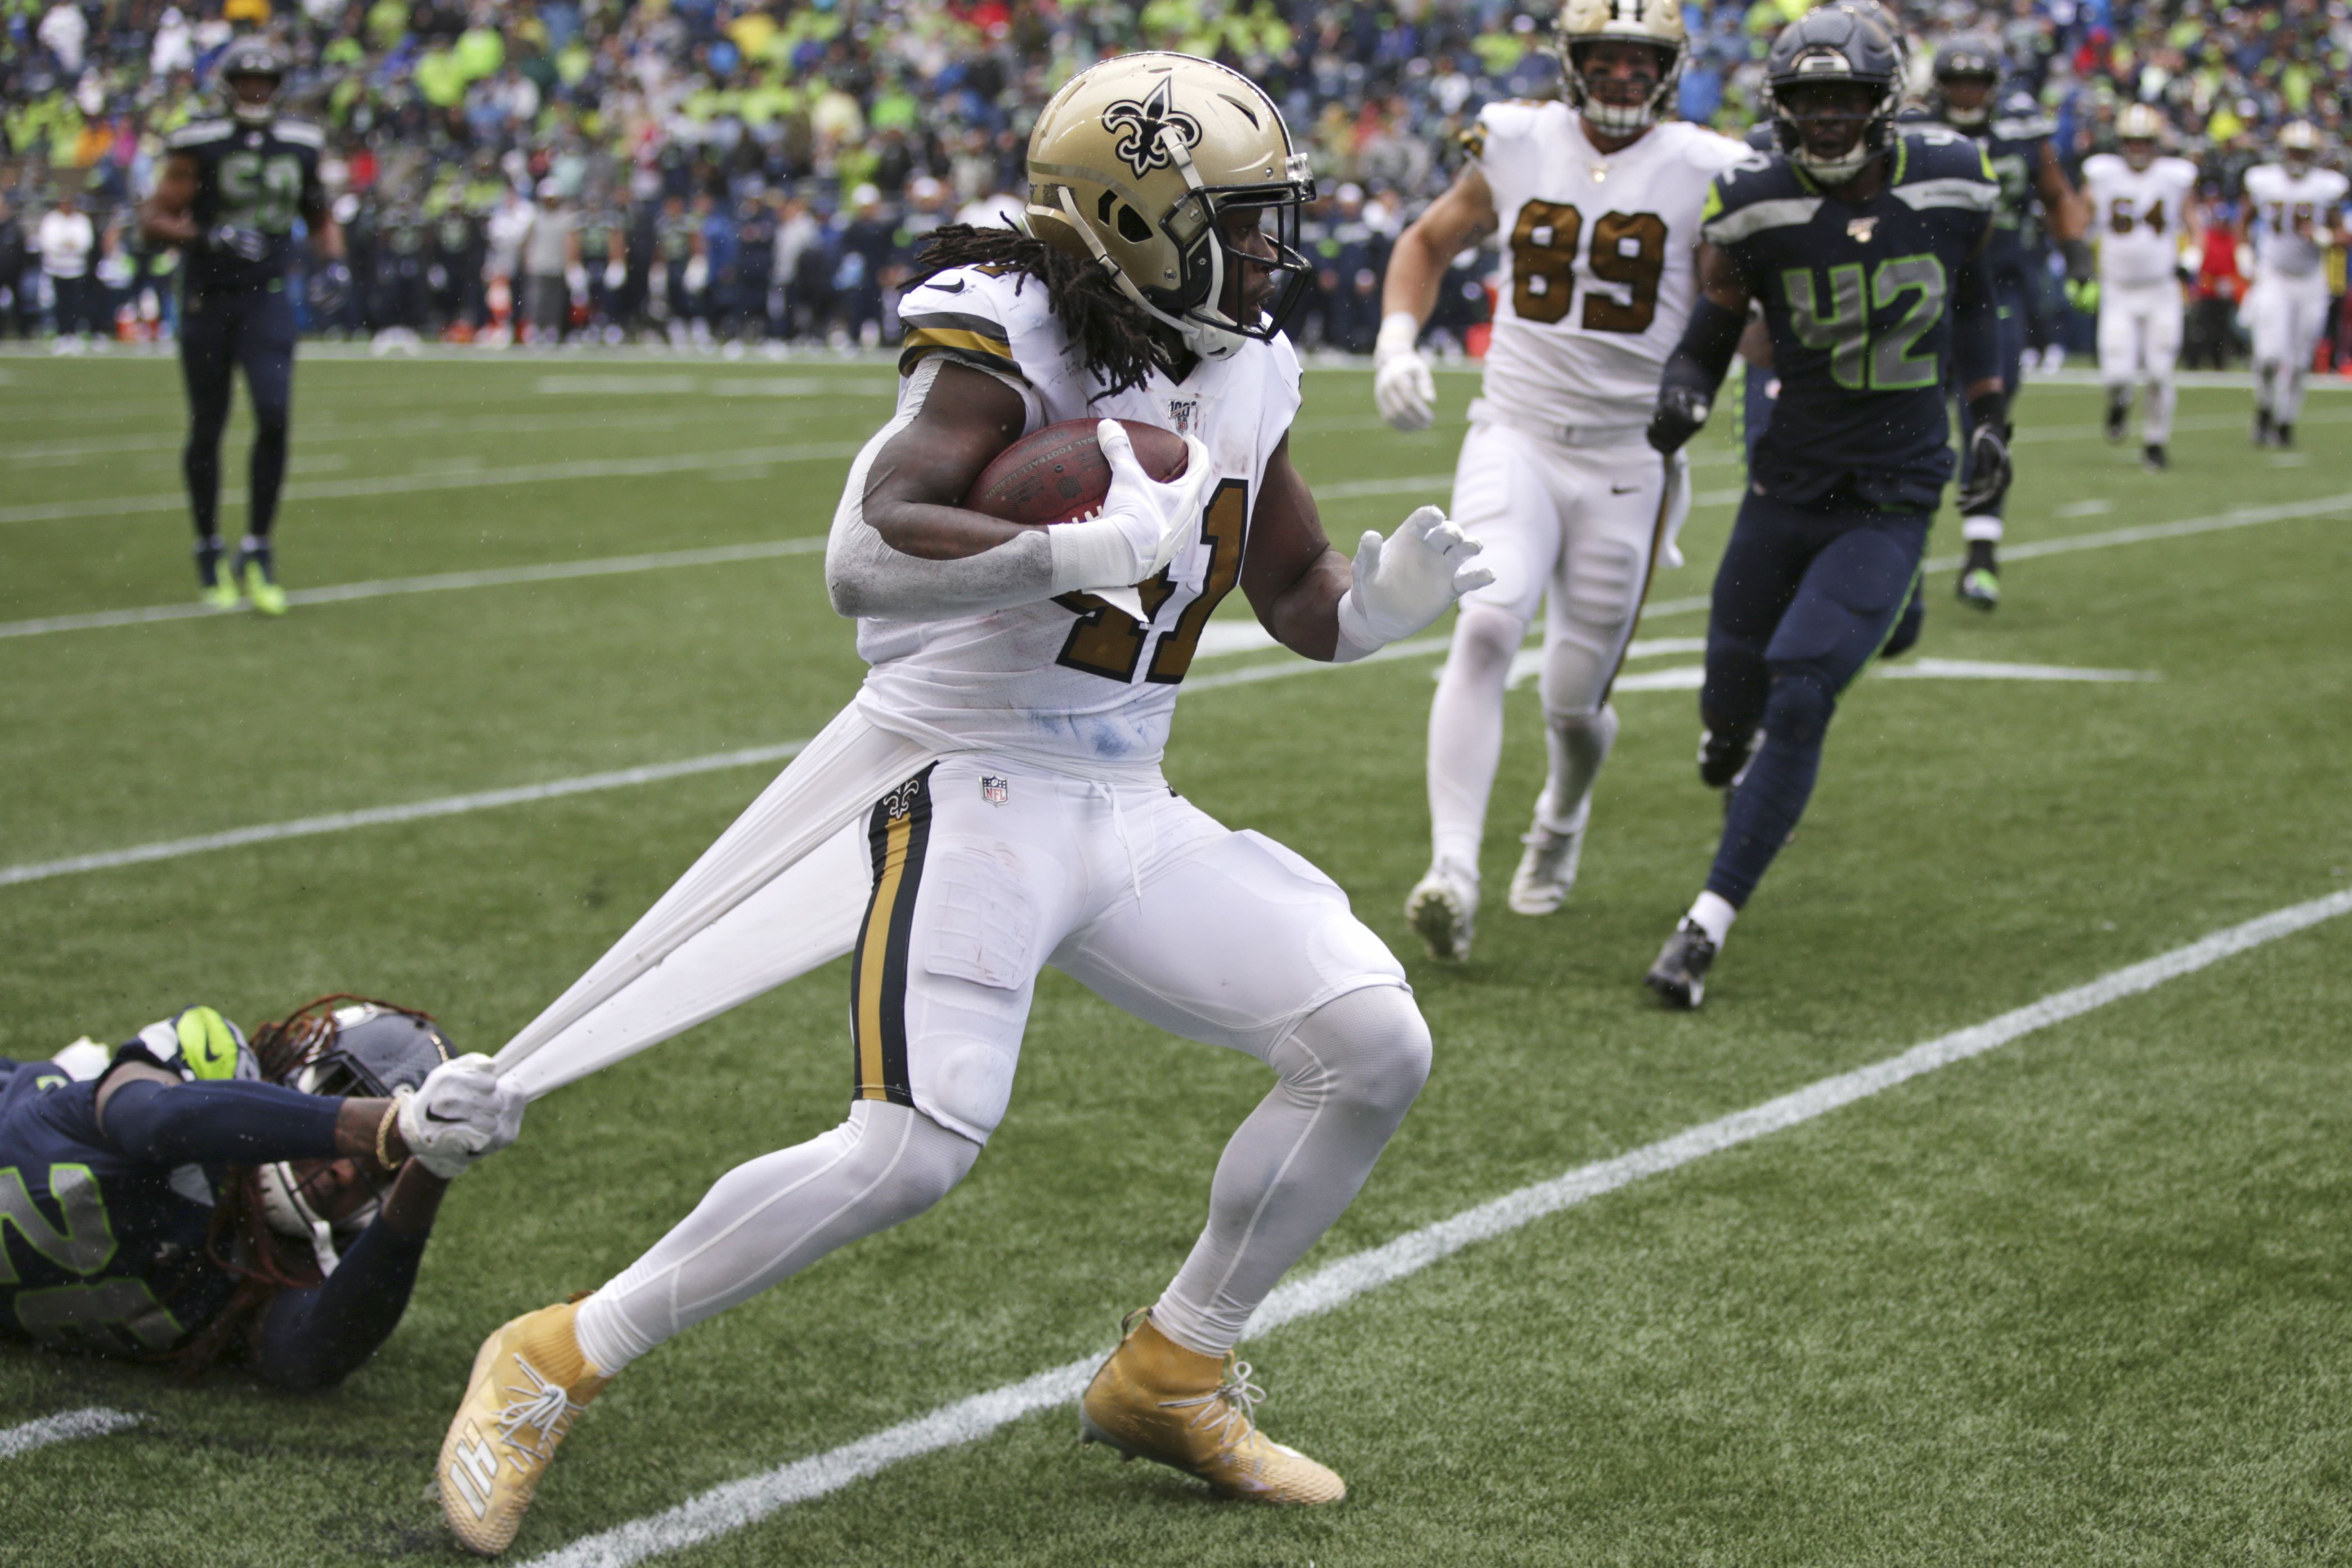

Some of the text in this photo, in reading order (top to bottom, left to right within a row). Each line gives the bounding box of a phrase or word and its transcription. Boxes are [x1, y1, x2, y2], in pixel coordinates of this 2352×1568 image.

[2109, 198, 2167, 235] 64
[1511, 198, 1668, 333] 89
[1781, 253, 1947, 390] 42
[1020, 444, 1073, 473] FOOTBALL
[985, 787, 1006, 800] NFL
